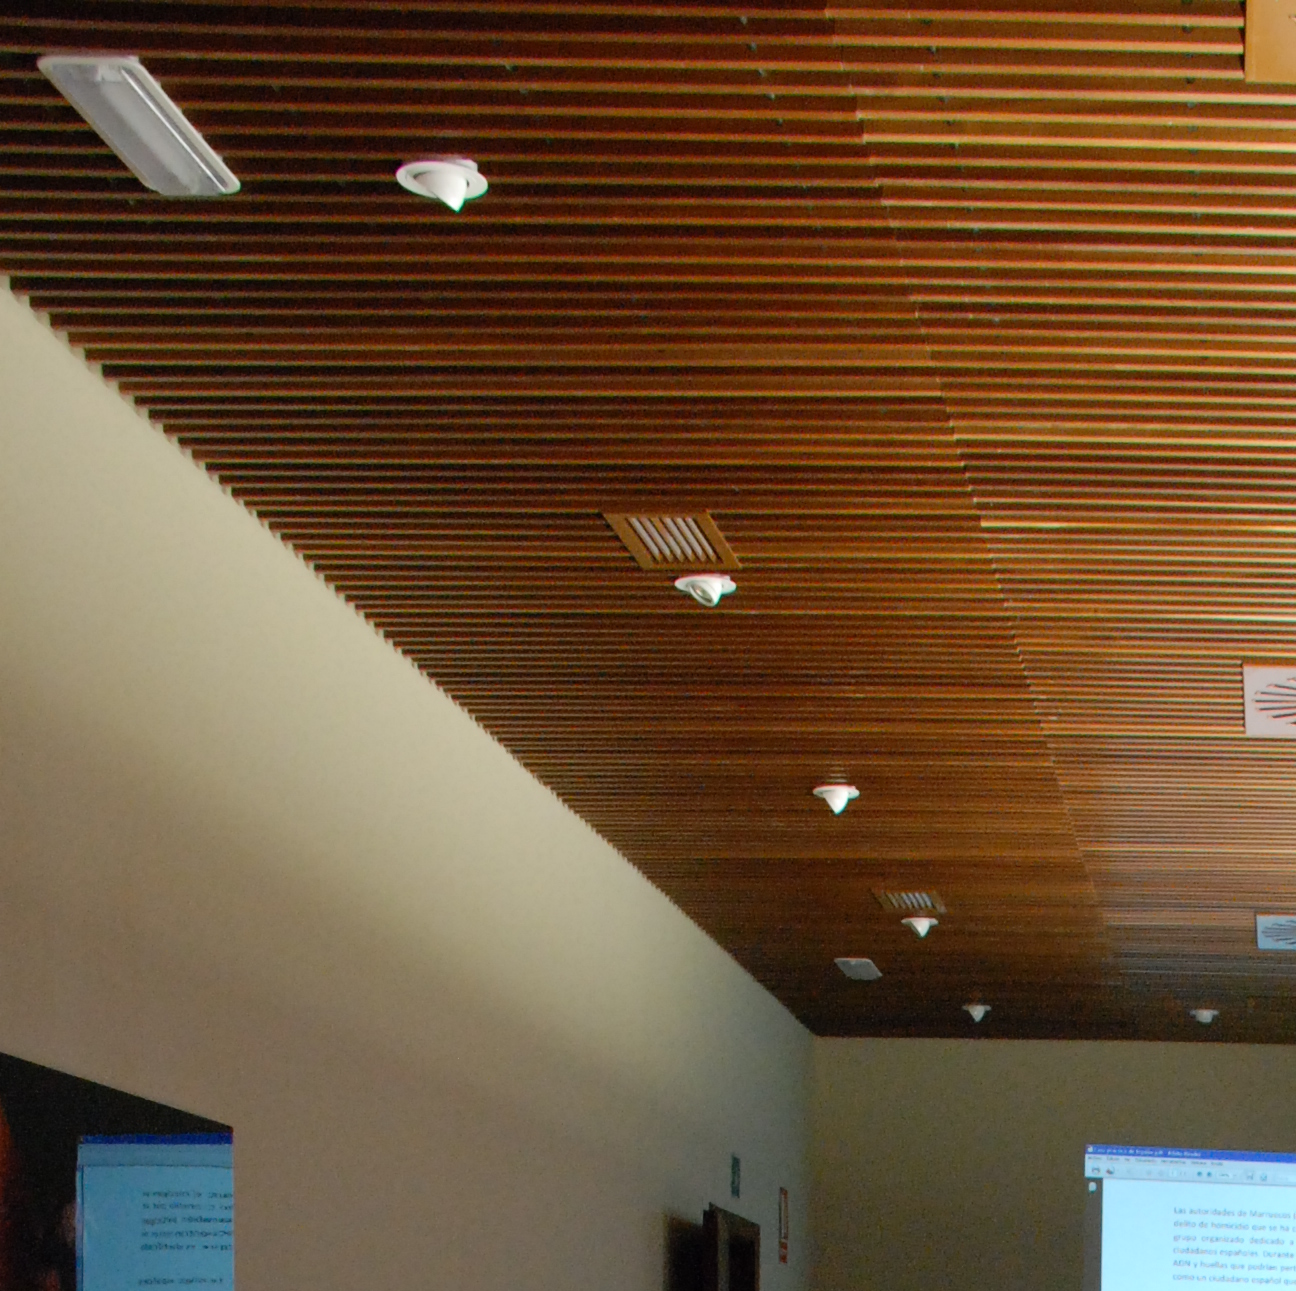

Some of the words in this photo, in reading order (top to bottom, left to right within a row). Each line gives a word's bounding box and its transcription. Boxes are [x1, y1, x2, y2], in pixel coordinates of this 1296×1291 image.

[1173, 1206, 1186, 1215] Las
[1251, 1223, 1266, 1231] que
[1173, 1258, 1191, 1267] ADN
[1230, 1263, 1245, 1271] que
